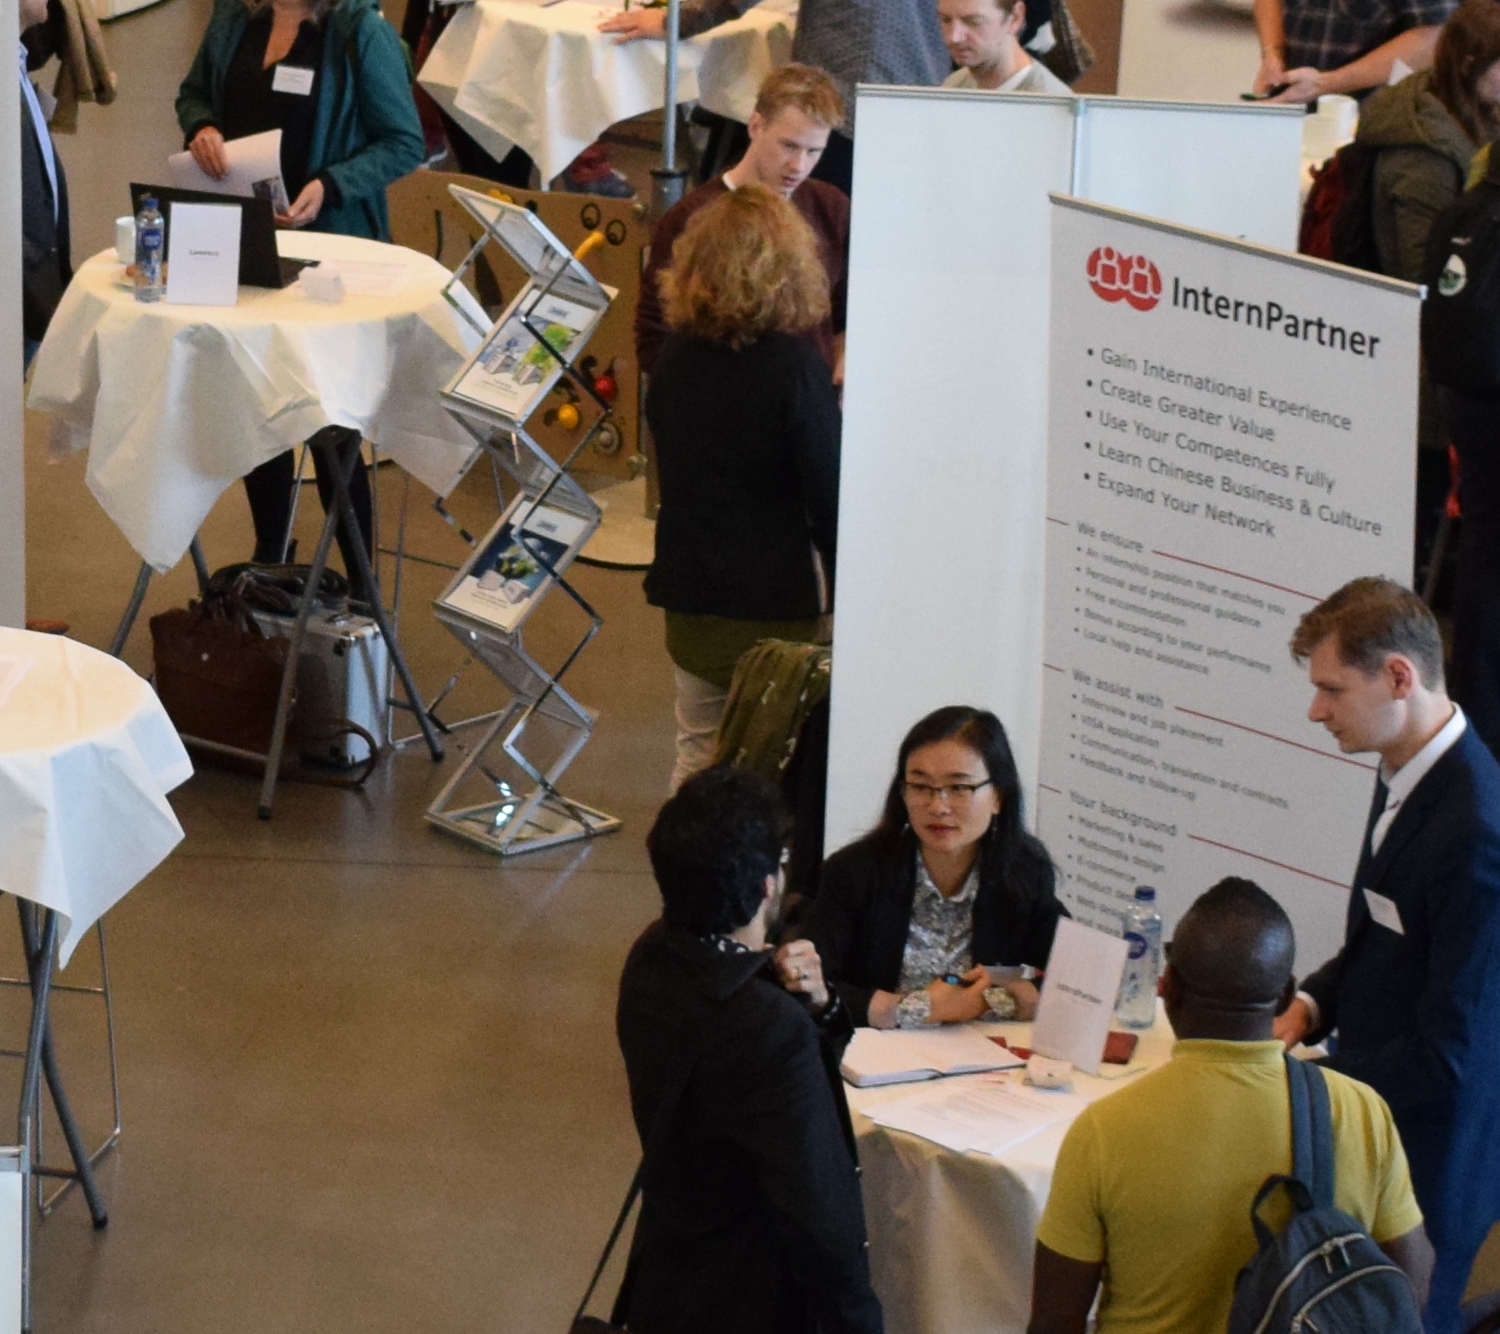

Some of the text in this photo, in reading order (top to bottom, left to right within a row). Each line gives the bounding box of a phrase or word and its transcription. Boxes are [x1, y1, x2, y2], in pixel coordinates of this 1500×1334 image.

[1171, 275, 1381, 360] InternPartner
[1100, 346, 1354, 432] Gain International Experience
[1100, 377, 1277, 443] Create Greater Value
[1097, 440, 1383, 539] Learn Chinese Business & Culture
[1098, 408, 1337, 496] Use Your Competences Fully
[1097, 473, 1277, 540] Expand Your Network
[1099, 529, 1145, 554] ensure
